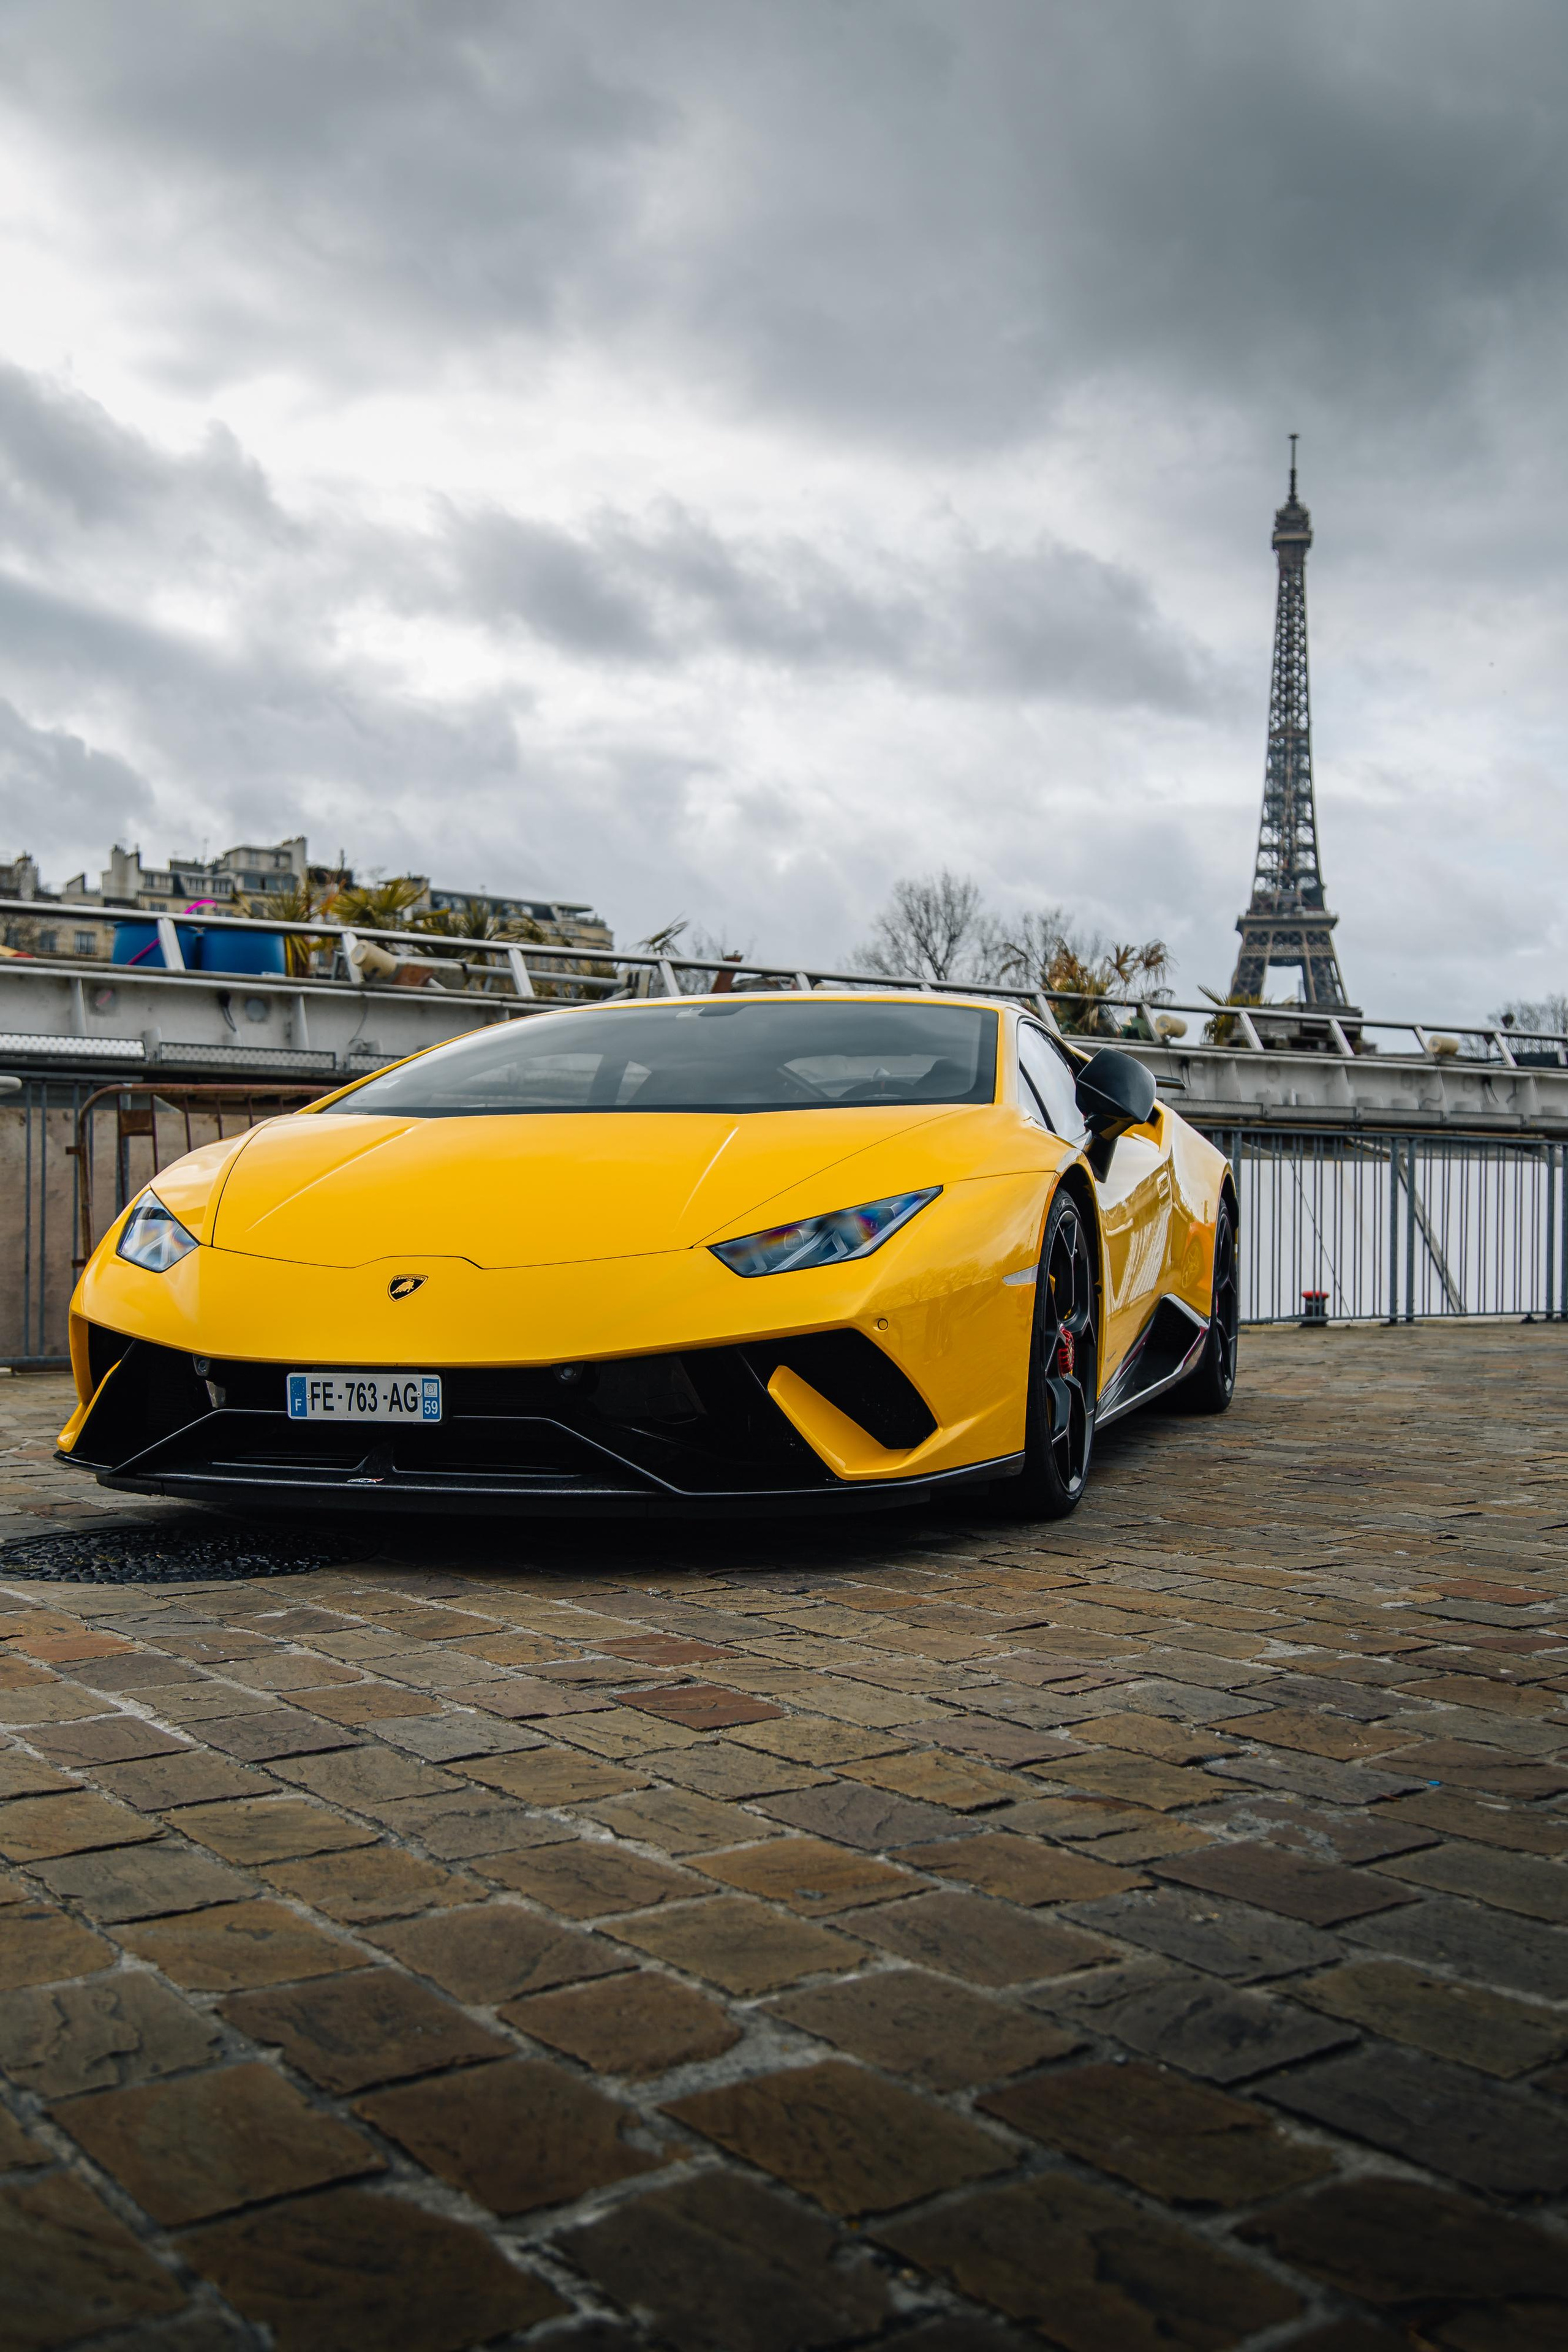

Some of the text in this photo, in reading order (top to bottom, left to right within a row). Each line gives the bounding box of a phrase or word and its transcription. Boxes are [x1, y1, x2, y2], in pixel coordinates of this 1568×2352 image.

[295, 1398, 302, 1411] F
[311, 1382, 418, 1413] FE-763-AG
[424, 1400, 438, 1415] 59
